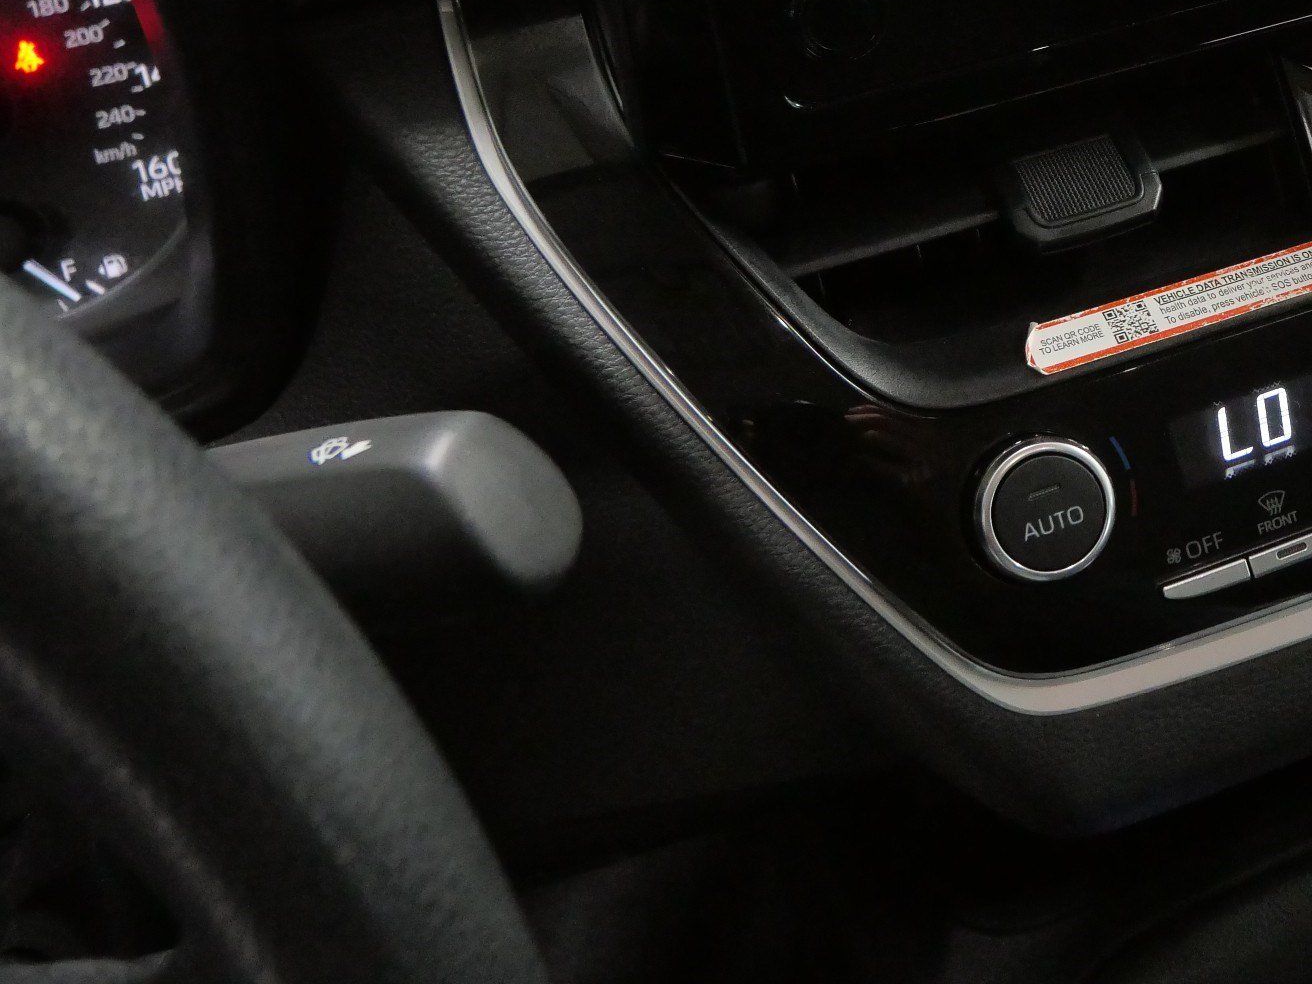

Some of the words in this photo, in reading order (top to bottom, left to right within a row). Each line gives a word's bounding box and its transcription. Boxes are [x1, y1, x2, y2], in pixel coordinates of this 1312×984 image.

[64, 24, 104, 49] 200
[90, 63, 128, 87] 220
[95, 105, 136, 130] 240
[60, 257, 77, 282] F
[1153, 286, 1196, 305] VEHICLE
[1196, 279, 1222, 291] DATA
[1222, 257, 1291, 285] TRANSMISSION
[1290, 254, 1301, 262] IS
[1159, 301, 1187, 314] health
[1187, 296, 1206, 306] data
[1207, 292, 1216, 300] to
[1218, 283, 1245, 296] deliver
[1164, 316, 1176, 324] To
[1178, 307, 1211, 320] disable,
[1211, 298, 1235, 312] press
[1271, 279, 1291, 291] SOS
[1039, 347, 1051, 355] TO
[1052, 338, 1080, 351] LEARN
[1080, 331, 1104, 343] MORE
[1040, 334, 1063, 346] SCAN
[1064, 330, 1077, 339] QR
[1077, 323, 1100, 335] CODE
[1024, 505, 1084, 542] AUTO
[1257, 510, 1299, 535] FRONT
[1185, 531, 1224, 559] OFF
